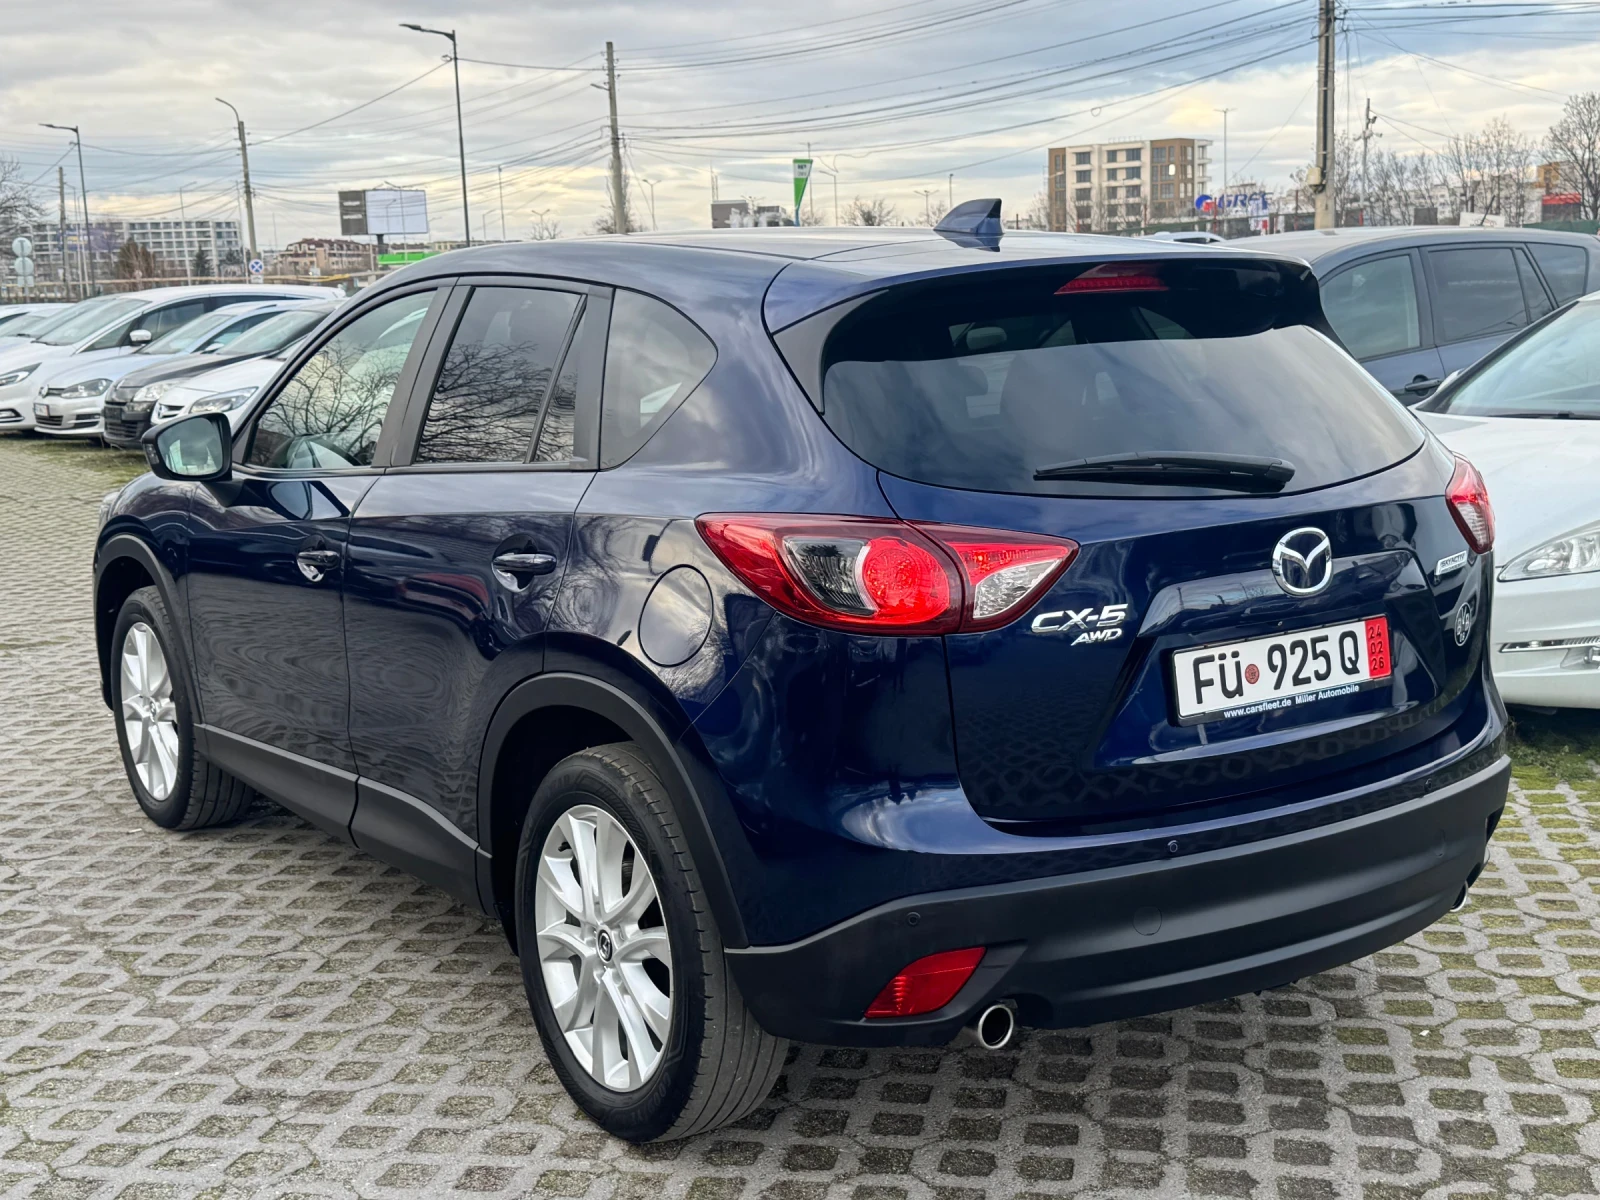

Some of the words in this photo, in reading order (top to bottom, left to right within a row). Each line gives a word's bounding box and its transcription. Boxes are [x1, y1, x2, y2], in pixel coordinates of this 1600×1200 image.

[1031, 604, 1128, 633] CX-5
[1070, 628, 1123, 646] AWD
[1369, 624, 1382, 639] 24
[1370, 641, 1384, 655] 02
[1192, 651, 1243, 704] FÜ
[1267, 634, 1331, 691] 925
[1338, 630, 1361, 676] Q
[1371, 656, 1385, 671] 26
[1224, 699, 1291, 718] www.carsfleet.de
[1318, 685, 1359, 700] Automobile
